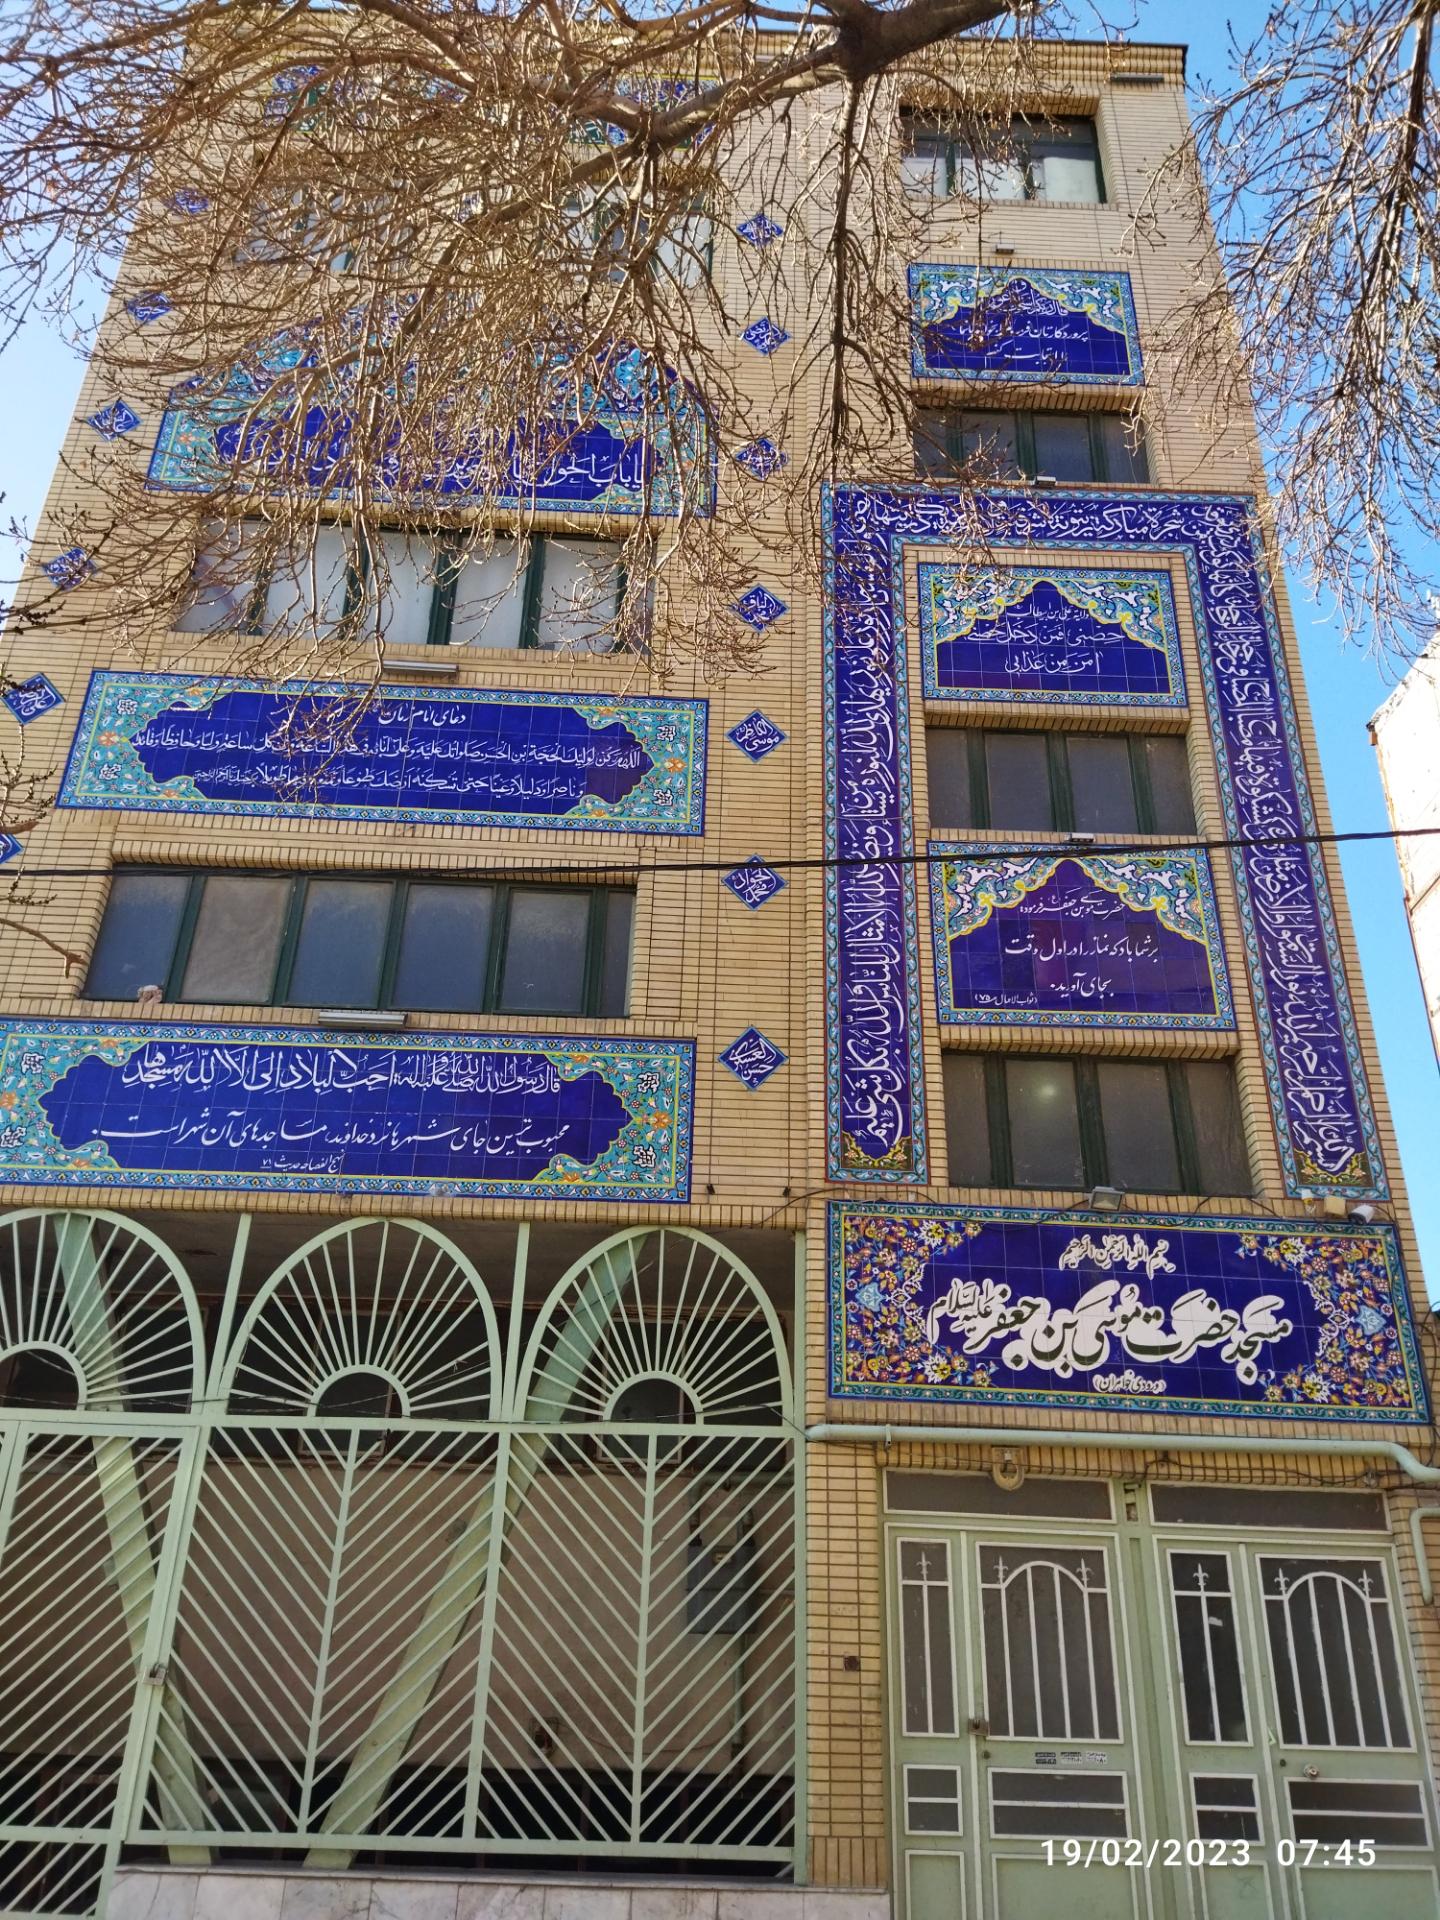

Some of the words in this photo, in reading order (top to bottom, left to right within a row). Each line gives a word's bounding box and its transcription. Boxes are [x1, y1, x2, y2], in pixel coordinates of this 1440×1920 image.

[963, 1284, 1051, 1371] جعفر
[1028, 1309, 1080, 1378] بن
[1071, 1280, 1143, 1372] موسی
[1122, 1288, 1240, 1364] حضرت
[1221, 1295, 1293, 1386] مسجد
